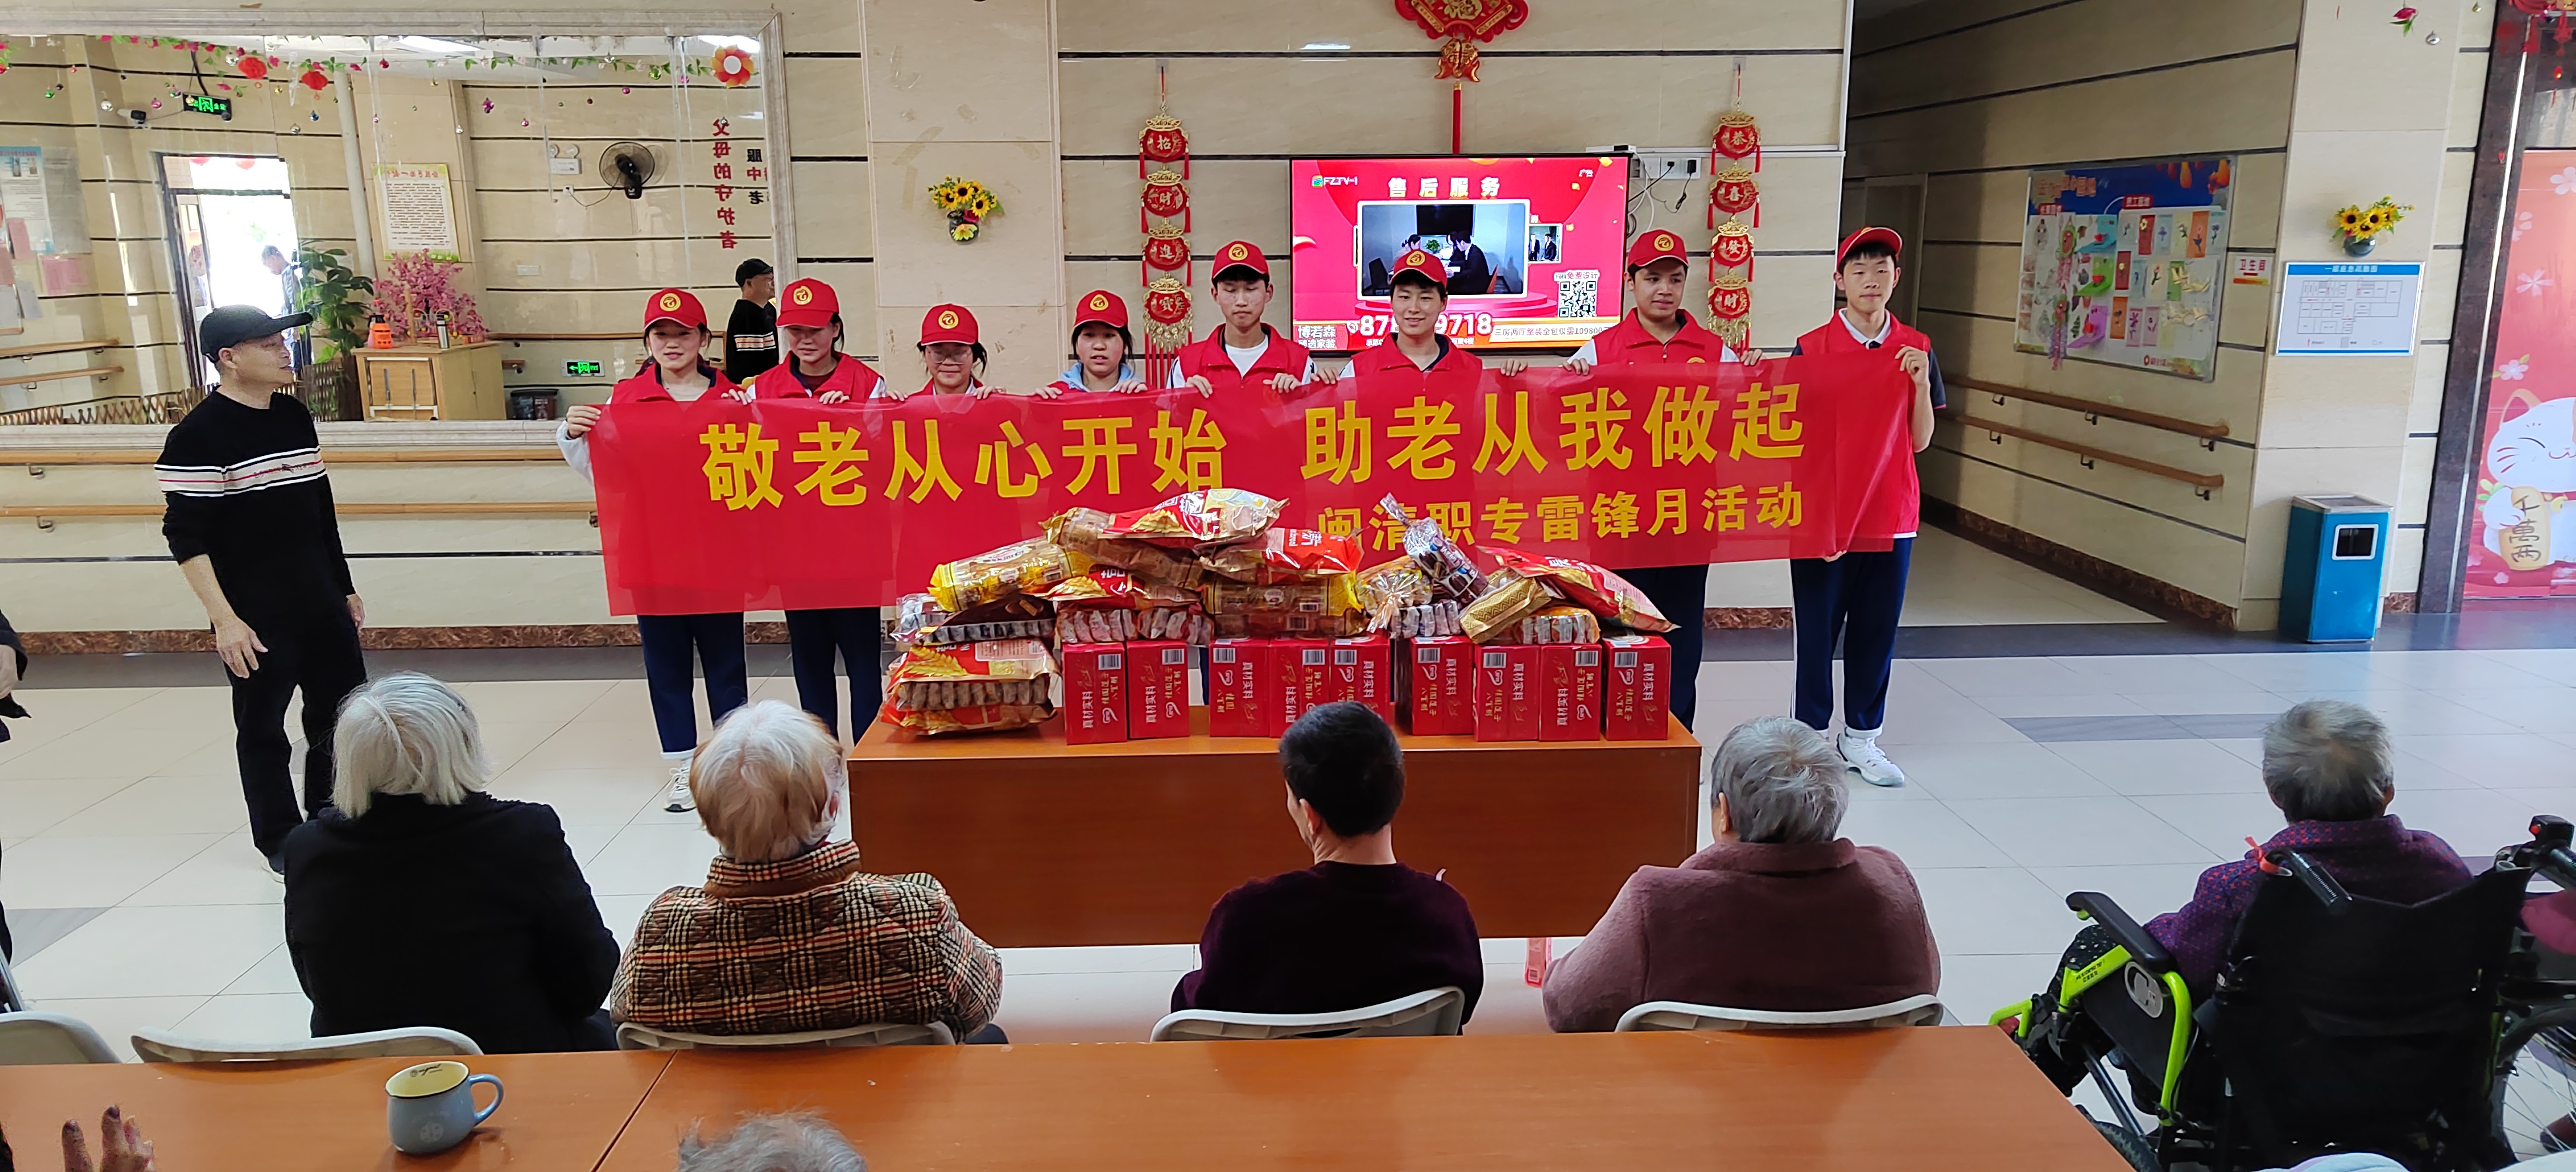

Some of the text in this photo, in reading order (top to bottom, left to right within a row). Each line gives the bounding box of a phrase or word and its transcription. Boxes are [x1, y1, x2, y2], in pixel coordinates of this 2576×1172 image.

[1324, 176, 1358, 185] FZTV-1
[1388, 177, 1500, 197] 售后服务
[2239, 259, 2266, 271] 卫生间
[1298, 325, 1336, 339] 博若森
[699, 381, 1805, 511] 敬老从心开始 助老从我做起
[1318, 481, 1803, 552] 闽清职专雷锋月活动
[1242, 662, 1254, 700] 真材实料
[1363, 661, 1374, 698] 真材实料
[1446, 659, 1457, 696] 真材实料
[1512, 663, 1524, 701] 真材实料
[1642, 663, 1654, 701] 真材实料
[1082, 691, 1093, 729] 真材实料
[1145, 686, 1156, 723] 真材实料
[1285, 686, 1297, 723] 真材实料
[1557, 688, 1568, 726] 真材实料
